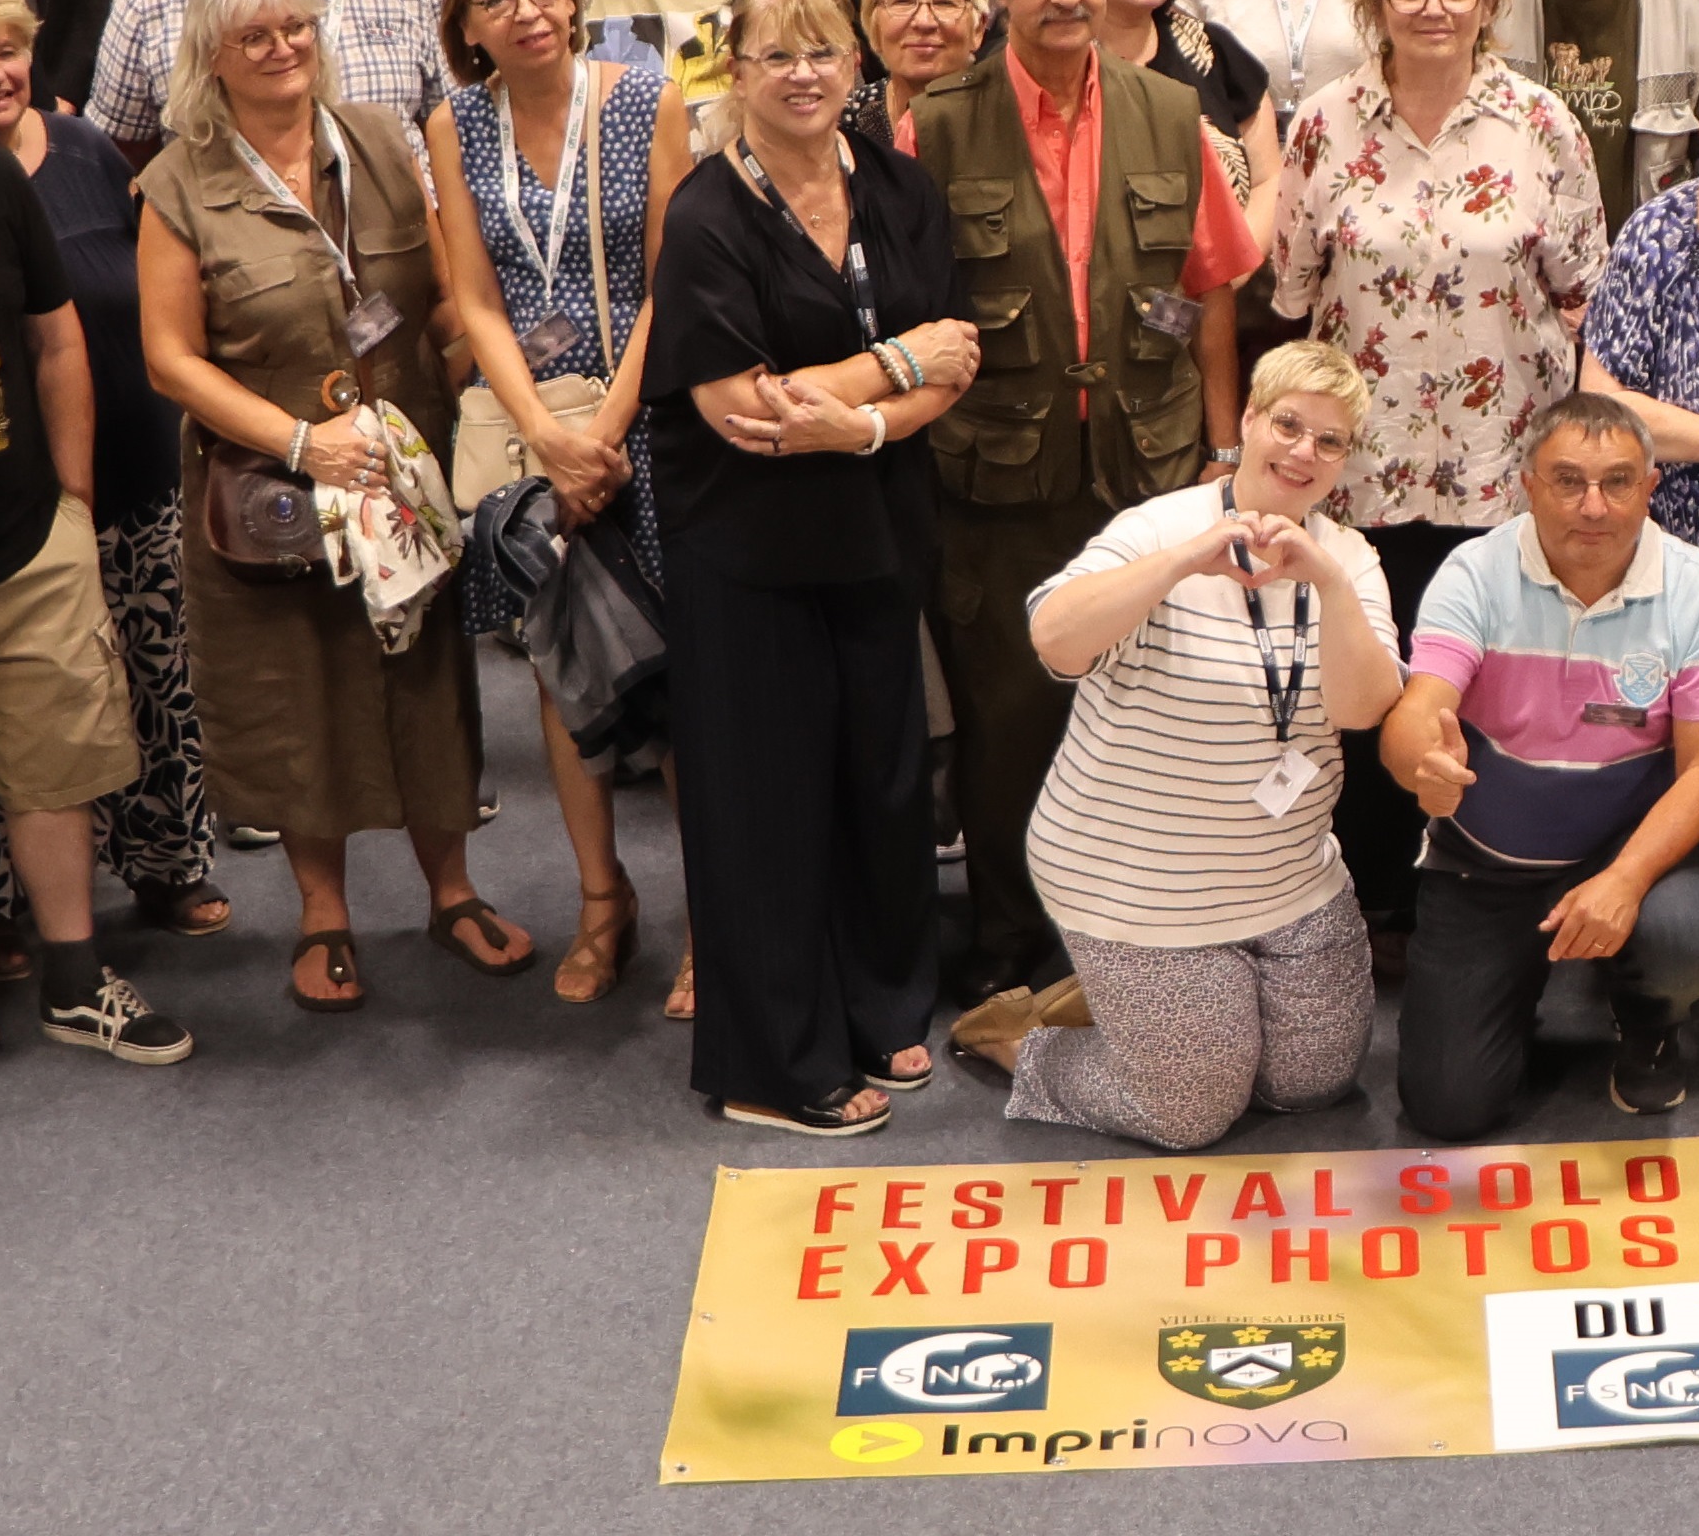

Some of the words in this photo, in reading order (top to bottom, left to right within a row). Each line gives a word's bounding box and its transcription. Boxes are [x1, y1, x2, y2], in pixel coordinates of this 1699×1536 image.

[813, 1169, 1353, 1235] FESTIVAL
[797, 1236, 1109, 1301] EXPO
[1186, 1213, 1681, 1288] PHOTOS
[1160, 1314, 1218, 1327] VILLE
[1226, 1314, 1255, 1324] DE
[1262, 1312, 1347, 1324] SALBRIS
[1574, 1297, 1666, 1340] DU
[941, 1418, 1351, 1466] Imprinova
